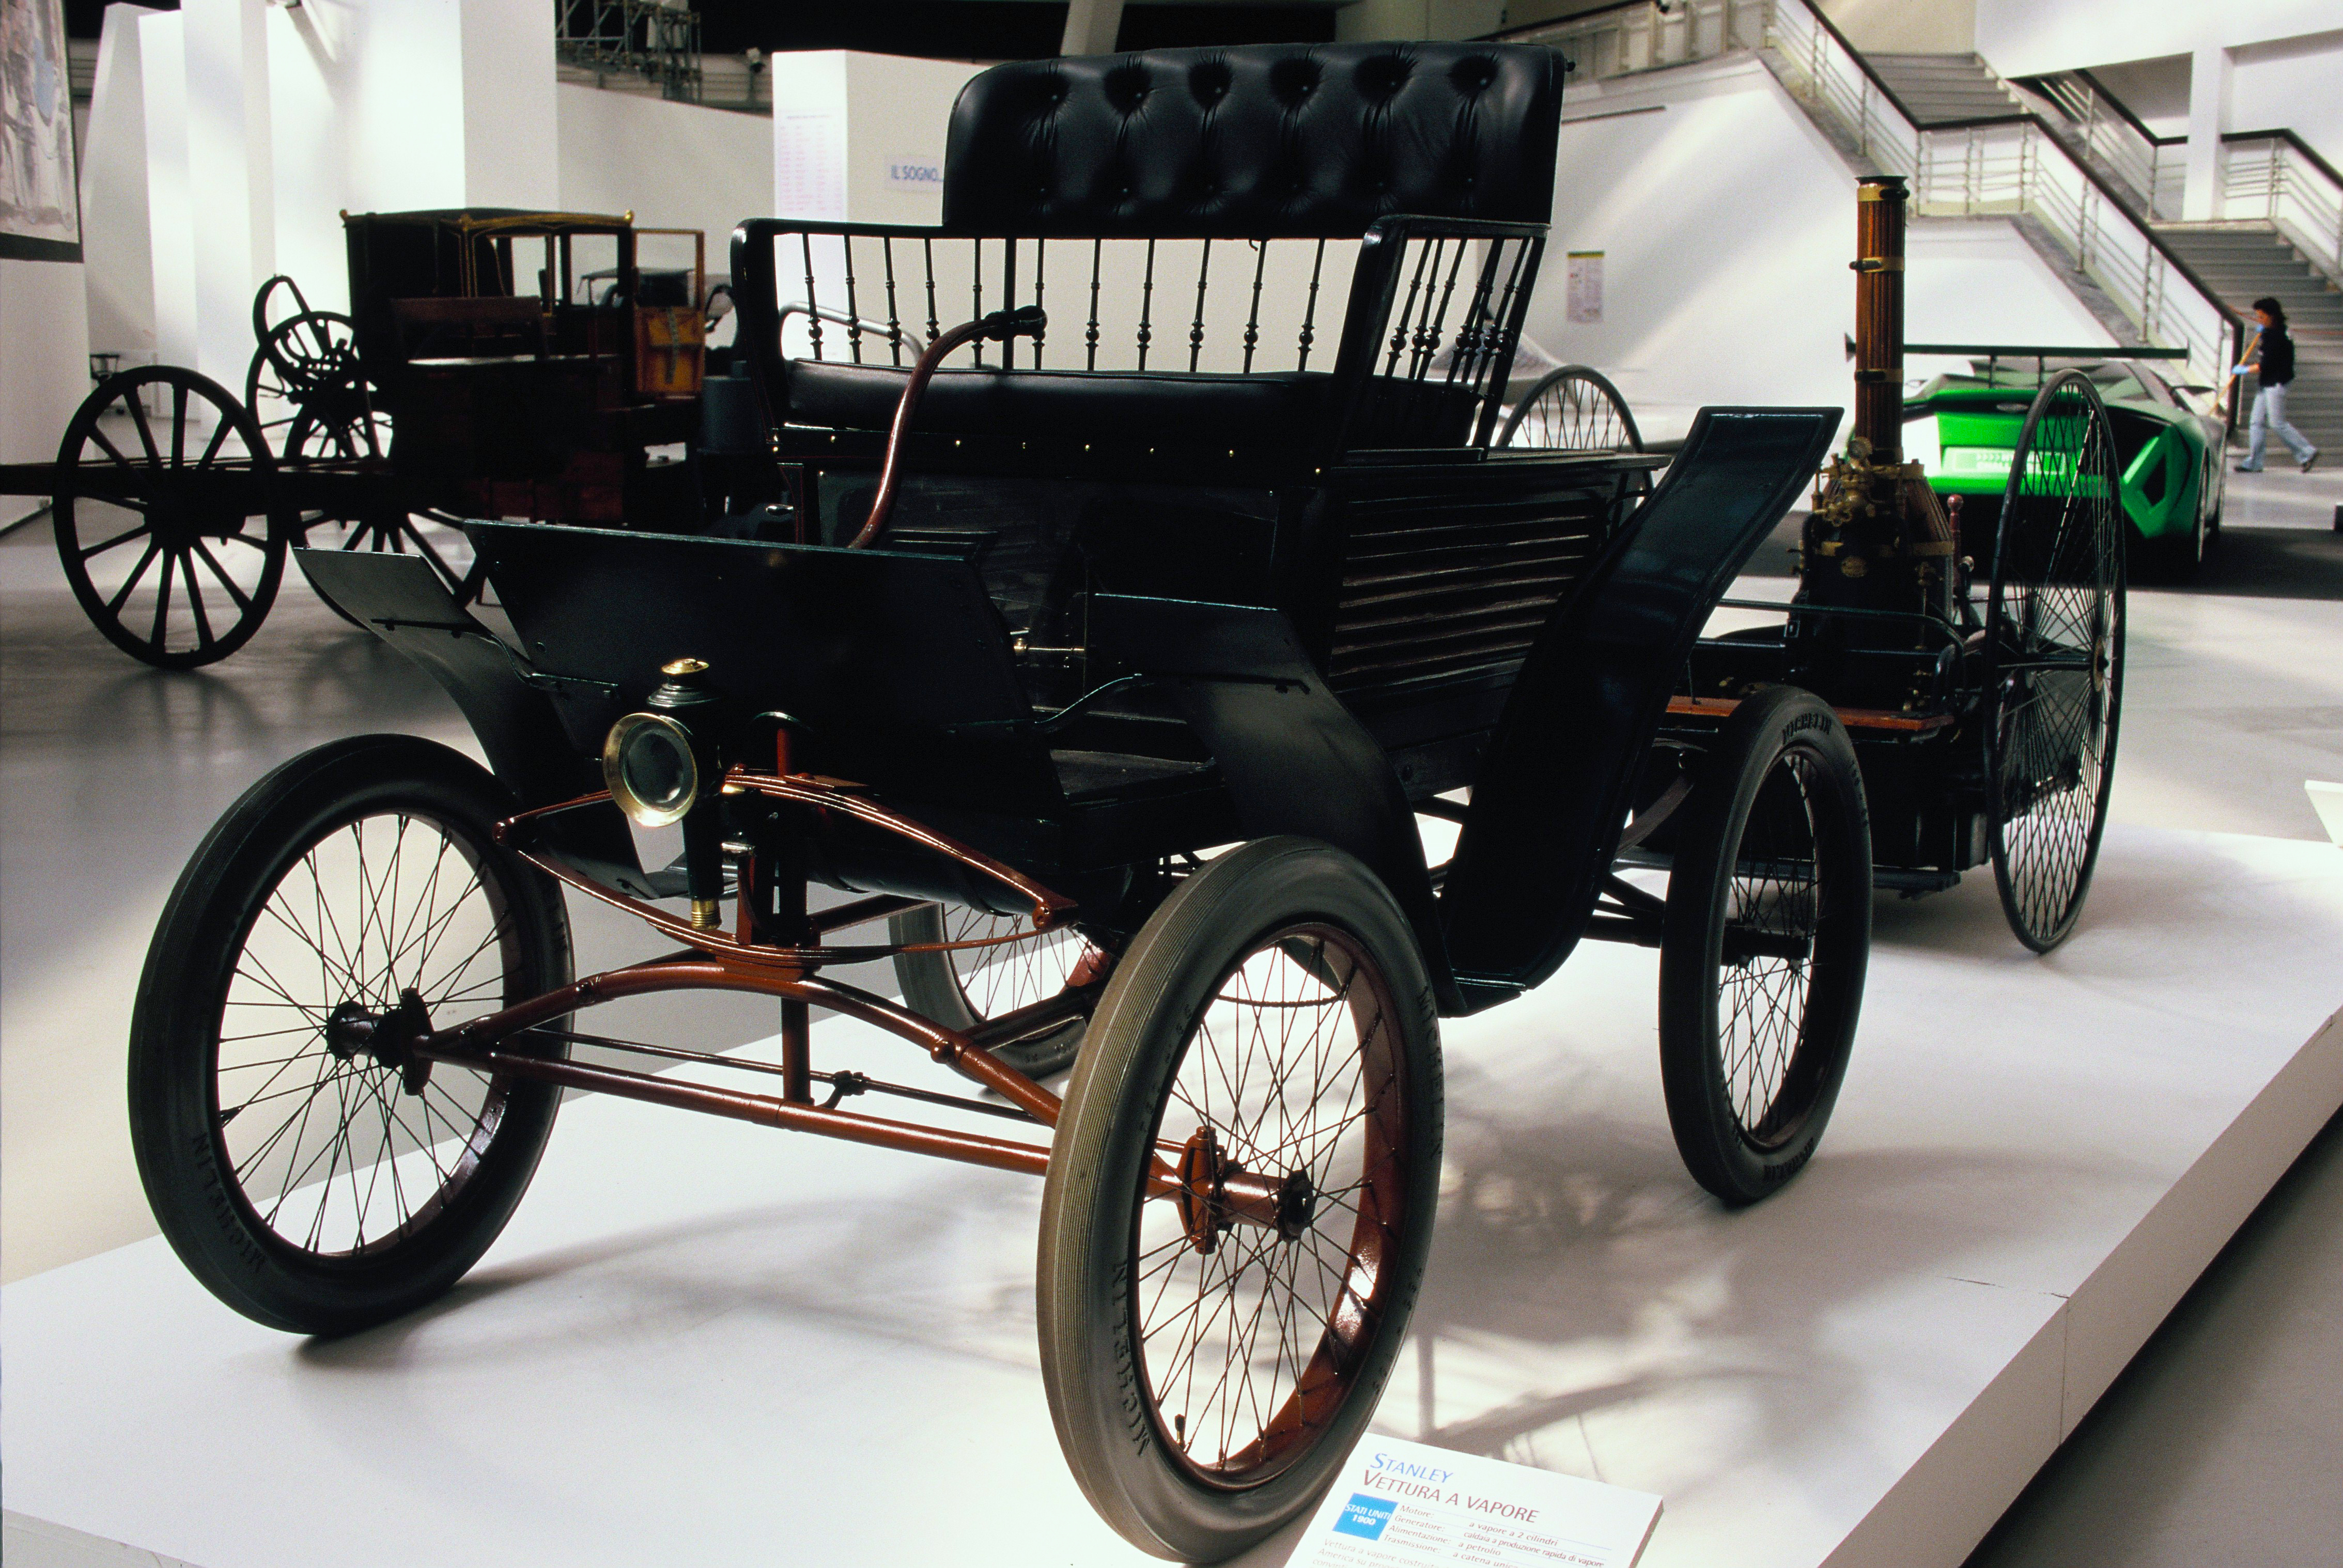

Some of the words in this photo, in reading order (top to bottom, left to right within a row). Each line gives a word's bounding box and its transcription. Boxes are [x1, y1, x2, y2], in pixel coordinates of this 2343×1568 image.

[891, 165, 899, 179] IL
[1112, 1263, 1150, 1456] MICHELIN
[1370, 1452, 1453, 1483] STANLEY
[1345, 1503, 1367, 1514] STATI
[1368, 1509, 1392, 1520] UNITI
[1352, 1514, 1376, 1526] 1900
[1445, 1493, 1459, 1505] A
[1467, 1496, 1540, 1523] VAPORE
[1388, 1525, 1452, 1545] Alimentazione:
[1466, 1543, 1501, 1556] petrolio
[1400, 1505, 1434, 1518] Motore:
[1478, 1524, 1507, 1534] vapore
[1526, 1534, 1559, 1546] cilindri
[1318, 1548, 1354, 1562] America
[1324, 1538, 1356, 1552] Vettura
[1367, 1550, 1397, 1561] vapore
[1384, 1534, 1441, 1553] Trasmissione:
[1461, 1554, 1491, 1565] catena
[1394, 1515, 1445, 1532] Generatore:
[1463, 1531, 1490, 1542] caldaia
[1498, 1540, 1541, 1554] produzione
[1542, 1549, 1566, 1560] rapida
[1578, 1558, 1605, 1568] vapore
